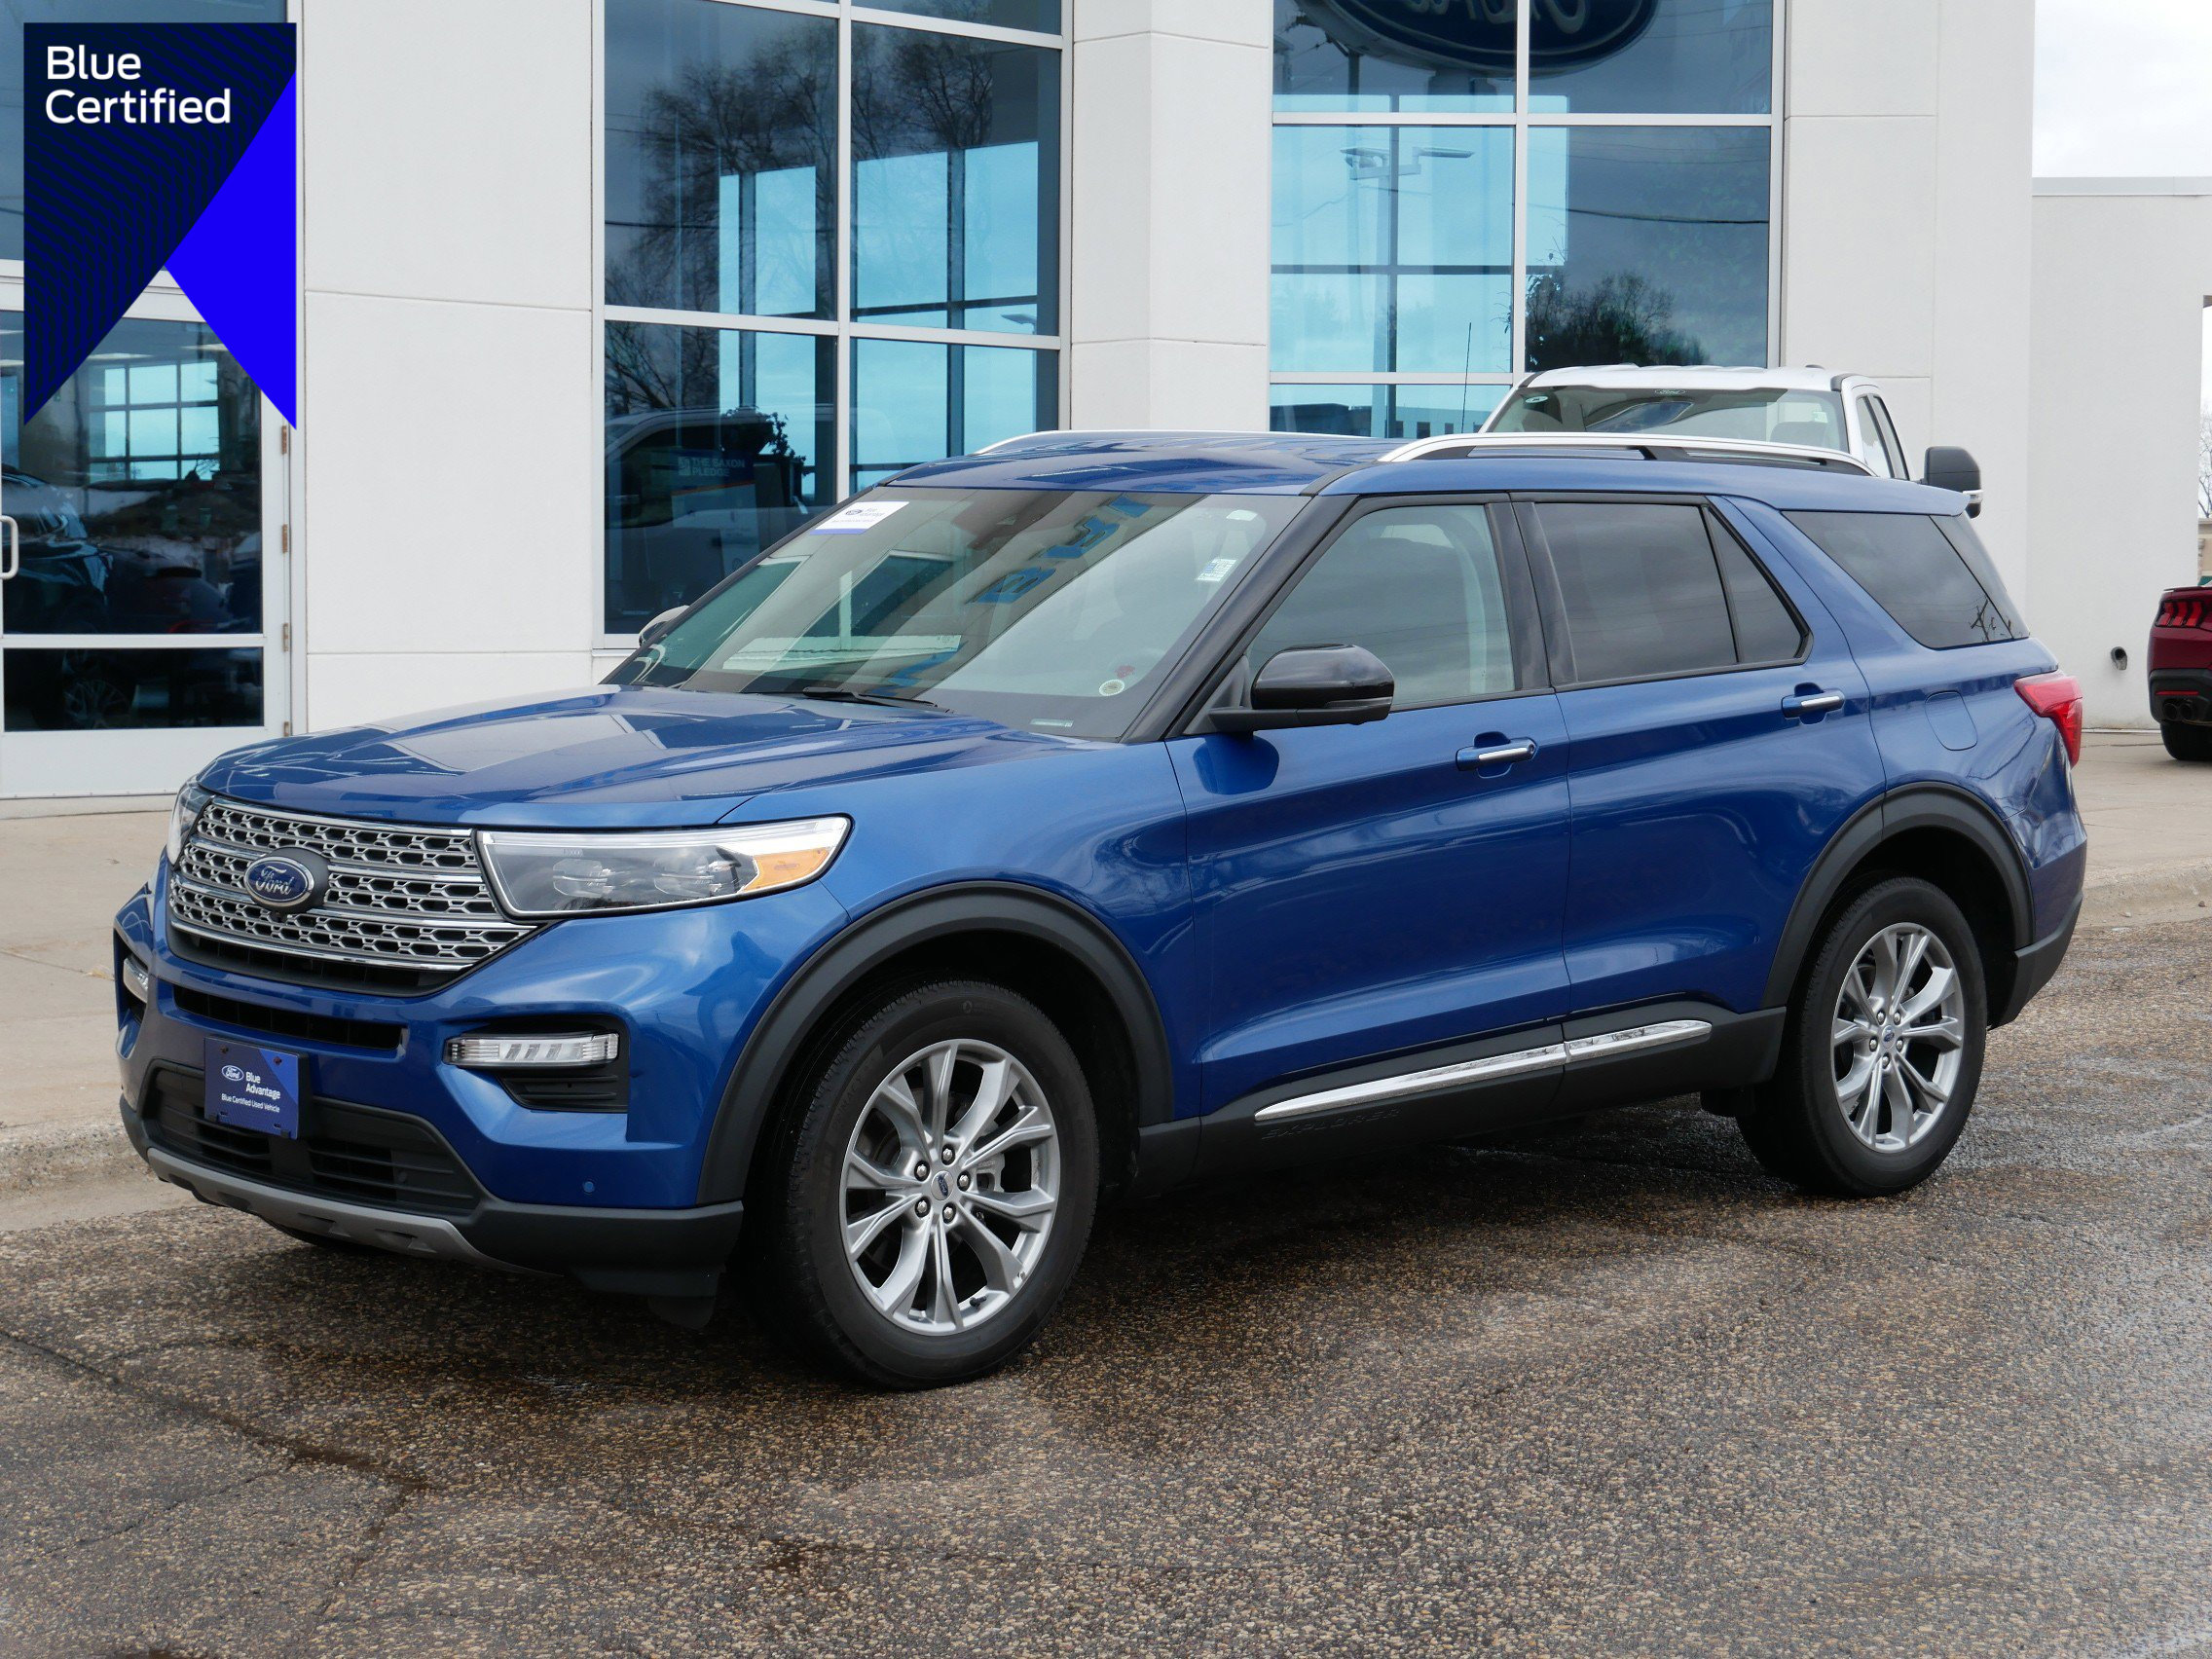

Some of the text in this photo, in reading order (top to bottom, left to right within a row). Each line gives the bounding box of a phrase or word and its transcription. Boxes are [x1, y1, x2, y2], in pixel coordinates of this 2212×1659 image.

[691, 458, 746, 468] THE SAXON
[692, 467, 729, 477] PLEDGE
[255, 866, 295, 895] Ford
[225, 1067, 240, 1079] Ford
[246, 1071, 261, 1084] Blue
[246, 1083, 281, 1100] Advantage
[222, 1093, 280, 1113] Blue Certified Used Vehicle
